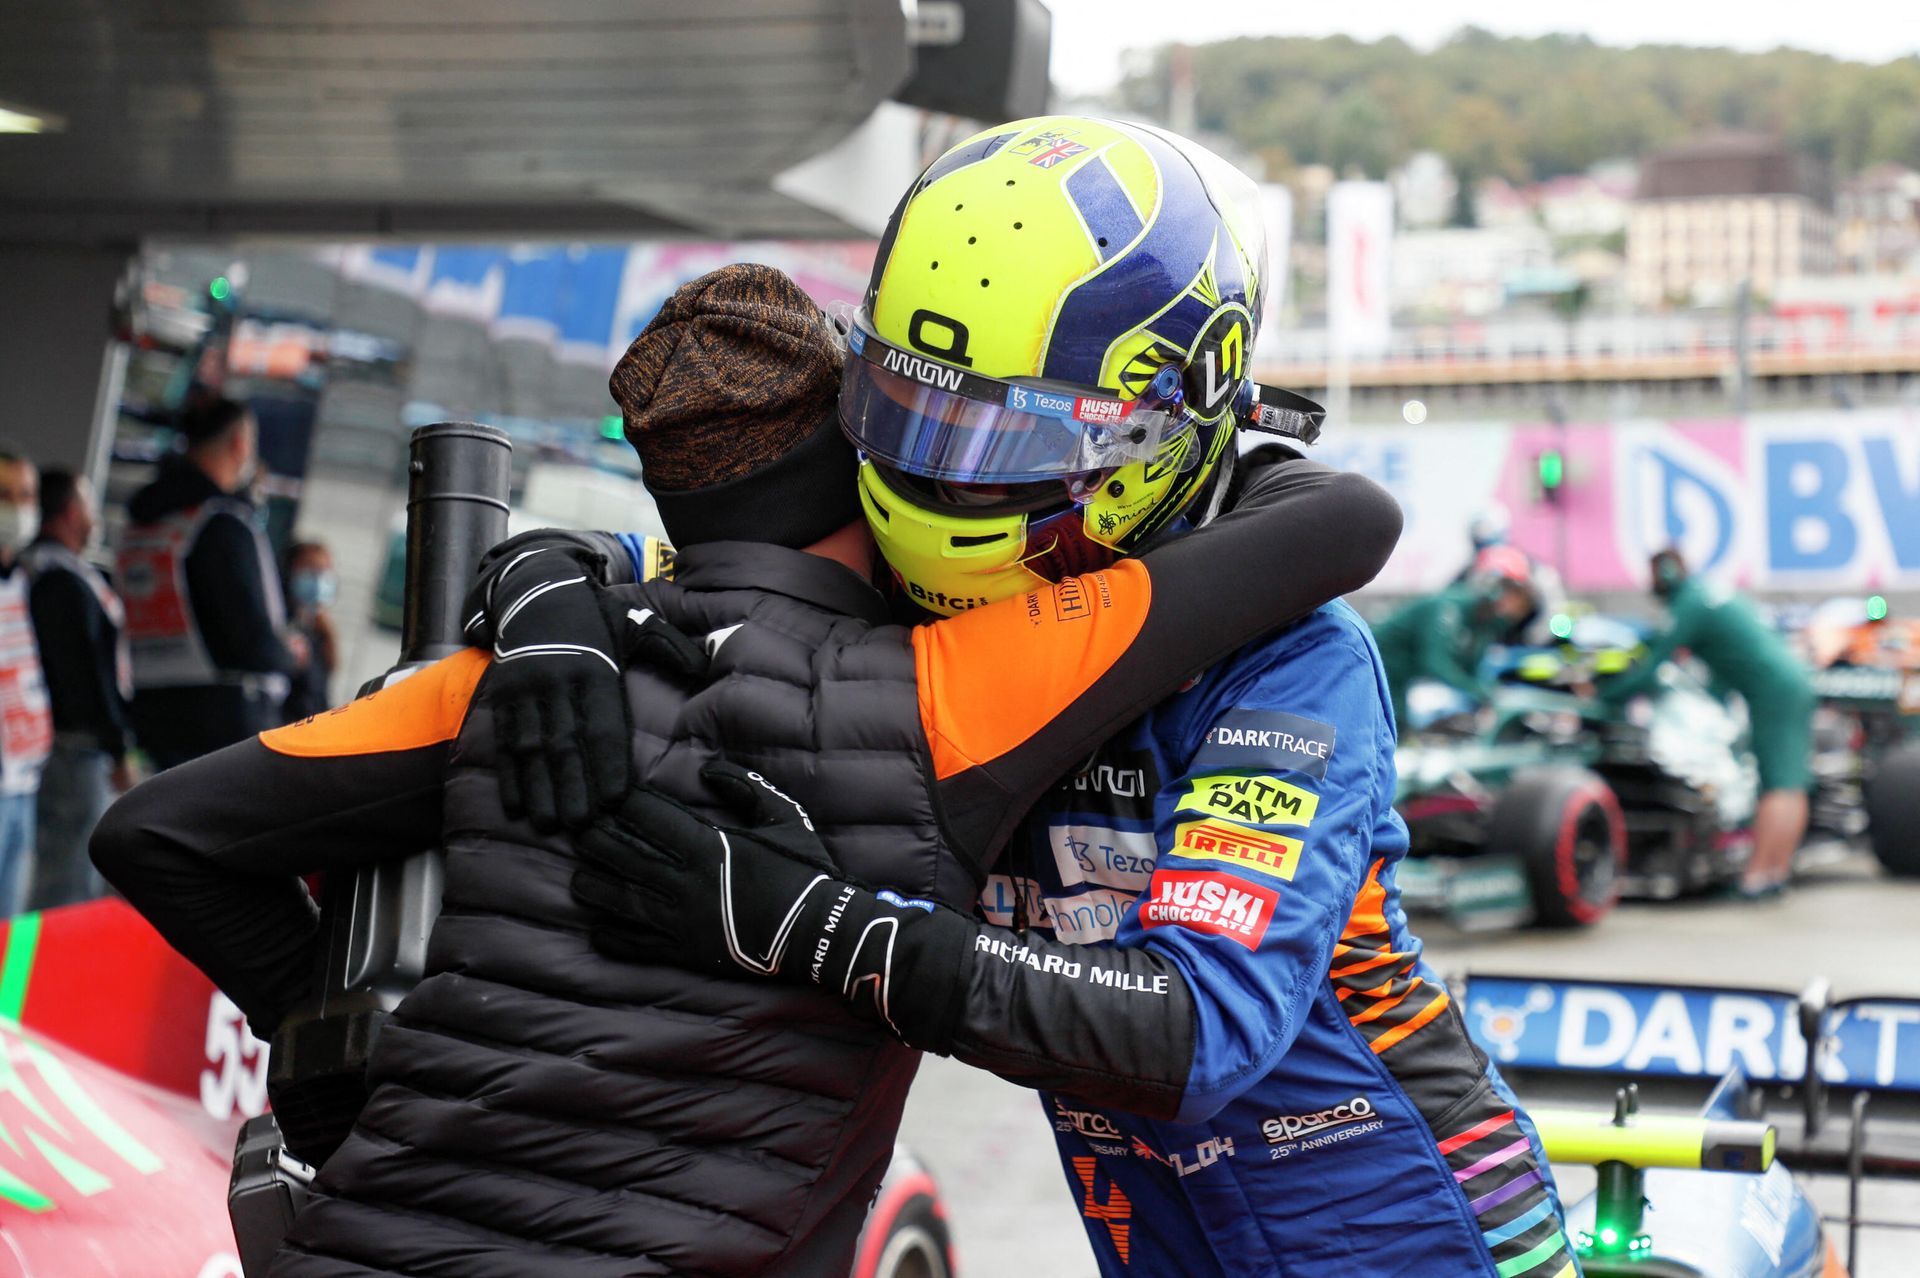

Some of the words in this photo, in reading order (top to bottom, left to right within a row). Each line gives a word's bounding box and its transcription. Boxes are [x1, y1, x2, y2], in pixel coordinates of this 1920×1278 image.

[883, 348, 964, 391] ARROW
[1033, 393, 1072, 412] Tezos
[1080, 398, 1123, 416] HUSKI
[1217, 727, 1328, 760] DARKTRACE
[824, 886, 856, 933] MILLE
[1148, 904, 1254, 936] CHOCOLATE
[975, 934, 1081, 979] RICHARD
[1089, 966, 1169, 995] MILLE
[1262, 1097, 1376, 1143] sparco
[1301, 1119, 1384, 1152] ANNIVERSARY
